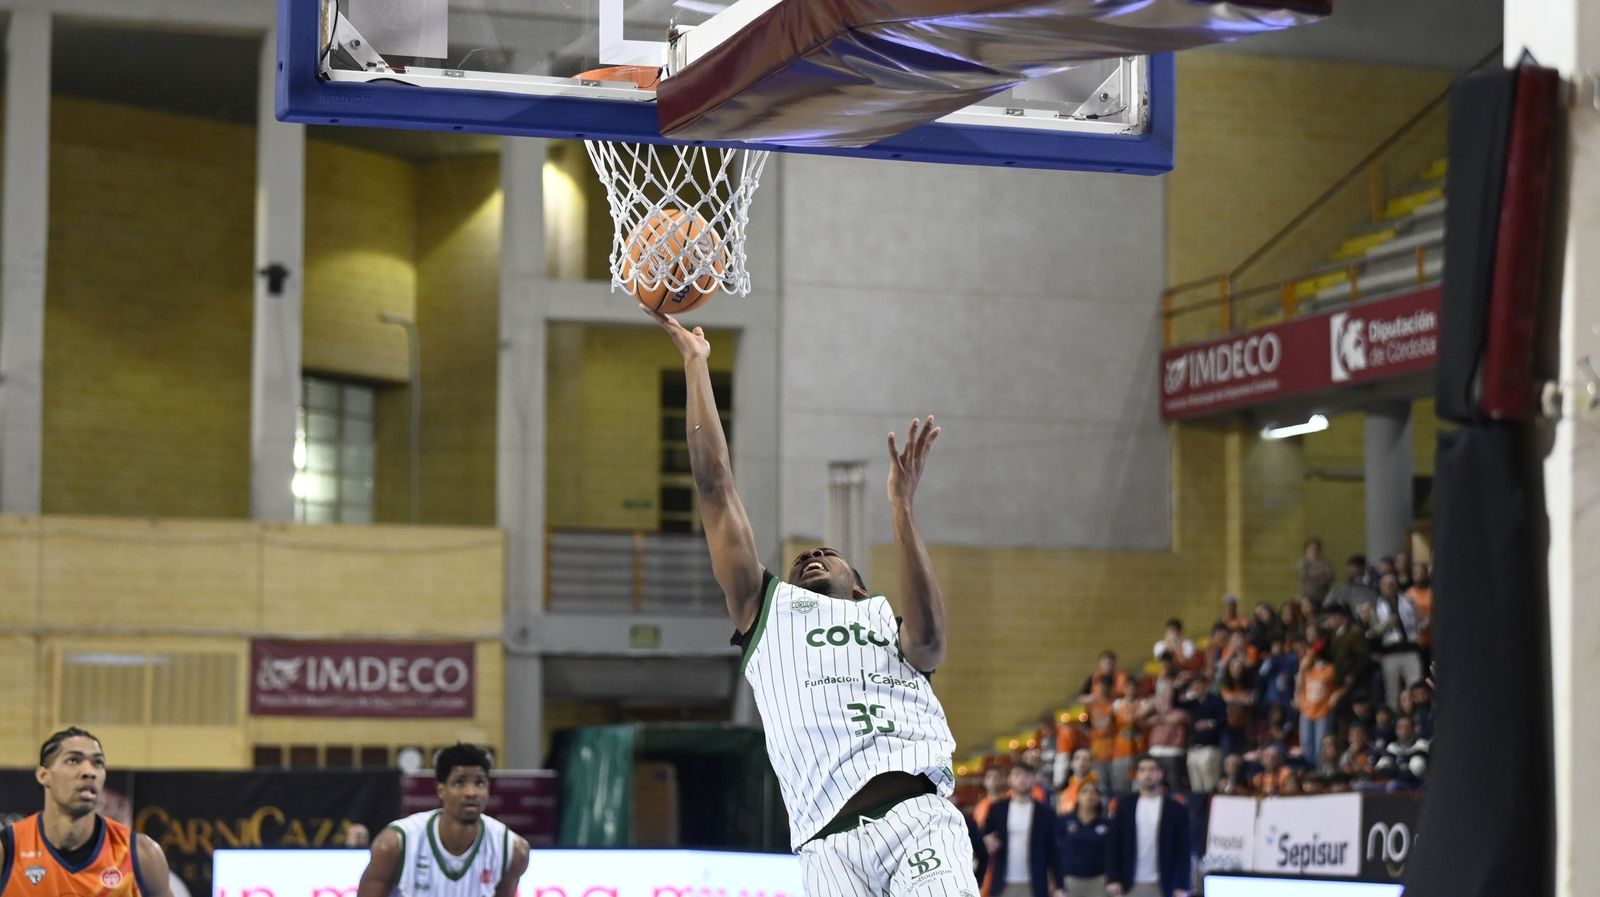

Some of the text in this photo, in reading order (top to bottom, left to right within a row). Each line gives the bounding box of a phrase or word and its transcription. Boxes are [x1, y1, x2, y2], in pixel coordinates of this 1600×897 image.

[1189, 332, 1281, 388] IMDECO
[306, 656, 469, 693] IMDECO
[868, 673, 919, 690] Cajasol
[1277, 832, 1348, 872] Sepisur
